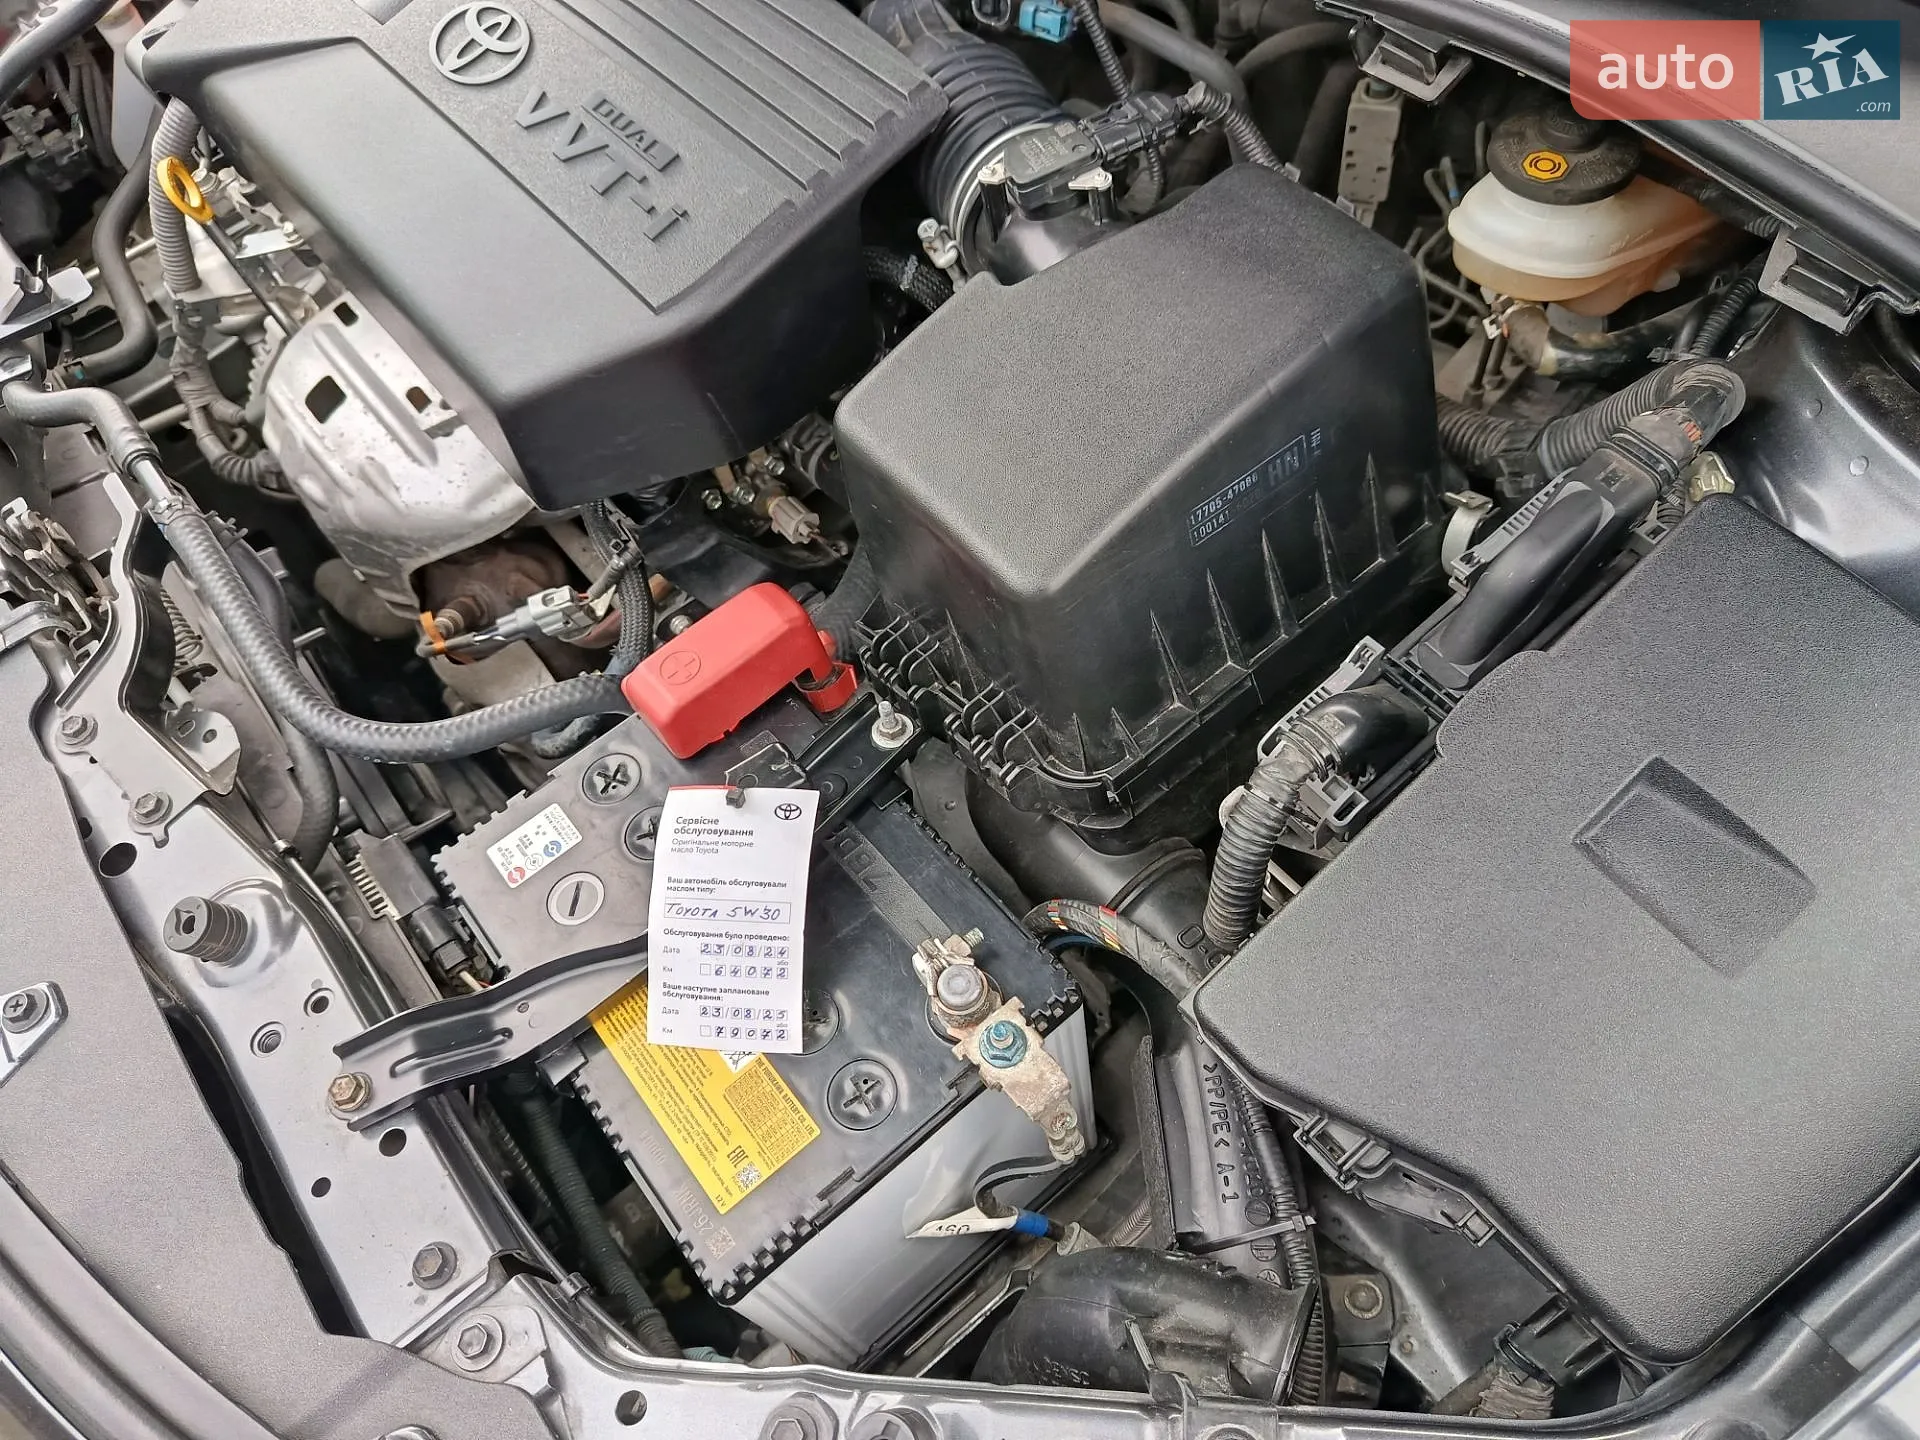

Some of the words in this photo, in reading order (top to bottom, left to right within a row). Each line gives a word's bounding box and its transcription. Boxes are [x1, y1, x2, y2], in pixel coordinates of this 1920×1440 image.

[591, 97, 662, 162] DUAL
[514, 85, 688, 241] VVT-i
[675, 816, 720, 826] Сервісне
[673, 826, 754, 838] обслуговування
[671, 838, 720, 848] Оригінальне
[720, 840, 755, 849] моторне
[695, 846, 719, 855] Toyota
[667, 876, 683, 884] Ваш
[684, 877, 727, 886] автомобіль
[728, 879, 787, 889] обслуговували
[696, 886, 716, 894] типу:
[663, 928, 724, 940] Обслуговування
[724, 931, 743, 941] було
[744, 933, 790, 943] проведено:
[662, 946, 681, 954] Дата
[662, 981, 682, 990] Ваше
[682, 985, 718, 994] наступне
[718, 987, 770, 996] заплановане
[662, 991, 723, 1001] обслуговування:
[661, 1006, 680, 1016] Дата
